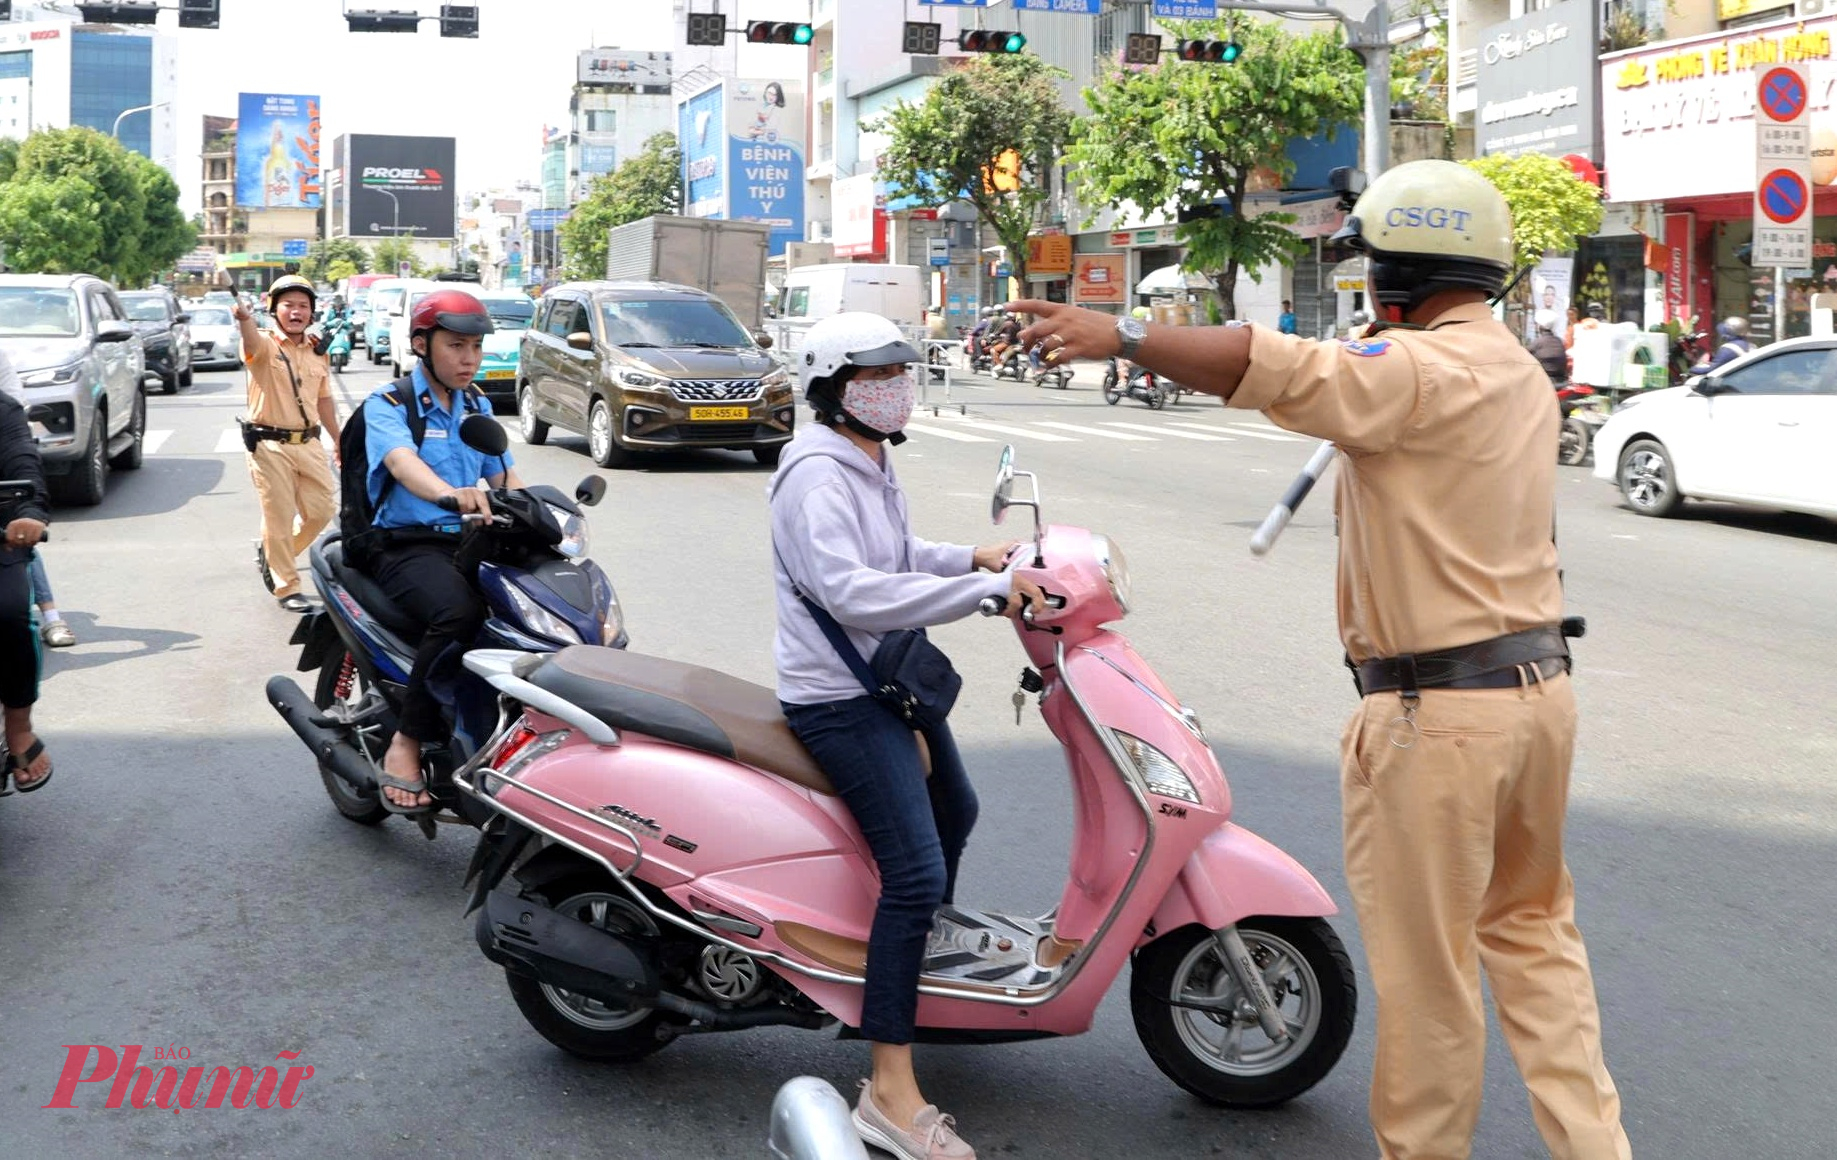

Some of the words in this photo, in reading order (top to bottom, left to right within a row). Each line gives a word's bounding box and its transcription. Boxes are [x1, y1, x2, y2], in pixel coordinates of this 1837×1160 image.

[741, 145, 792, 164] BỆNH
[362, 166, 426, 179] PROEL
[745, 164, 789, 184] VIỆN
[748, 183, 786, 199] THÚ
[761, 201, 774, 214] Y
[1386, 207, 1471, 232] CSGT
